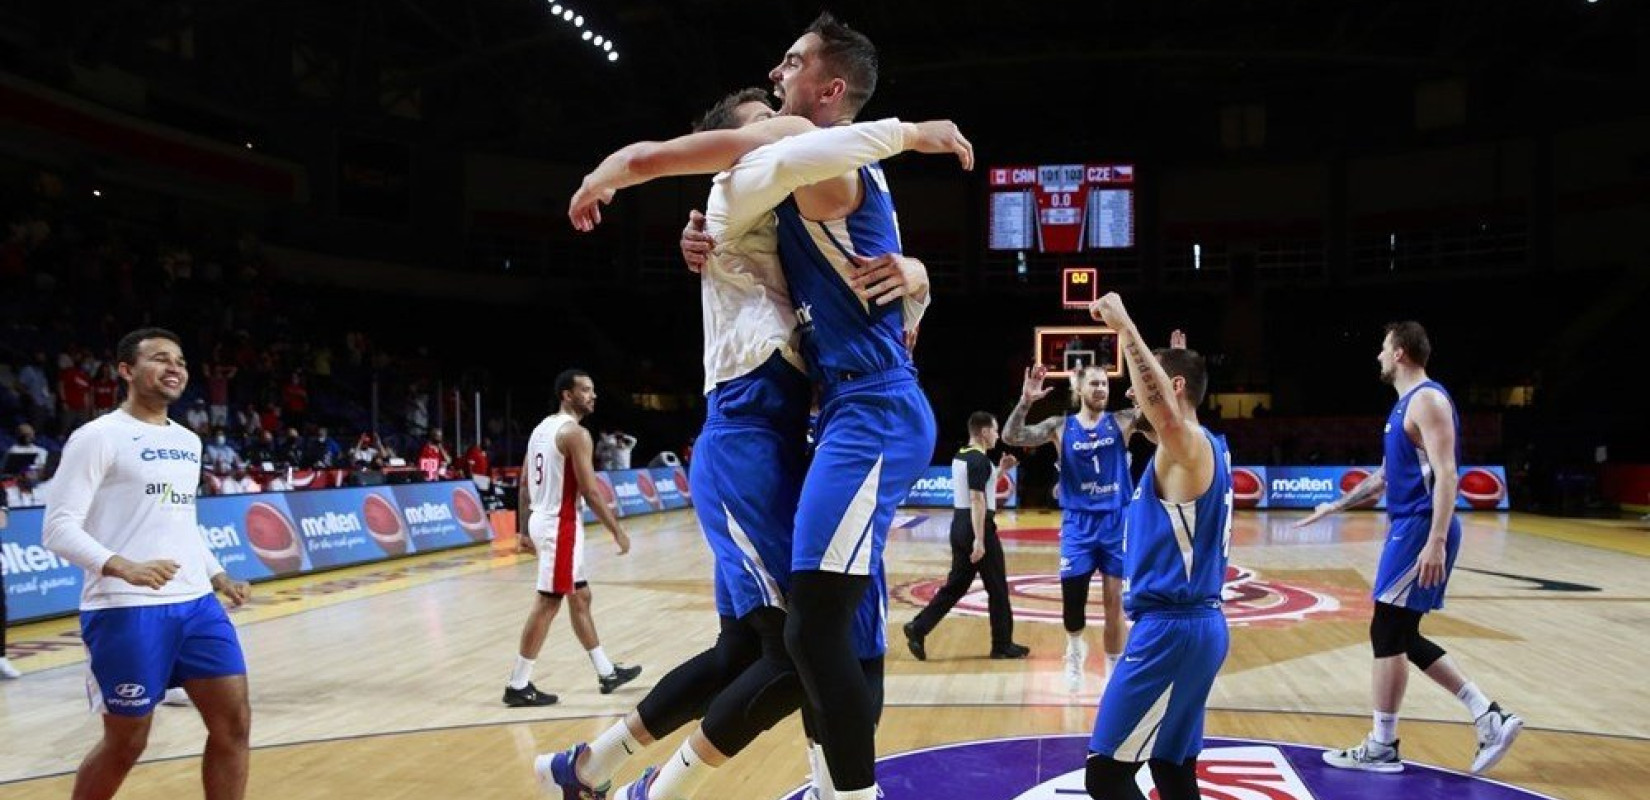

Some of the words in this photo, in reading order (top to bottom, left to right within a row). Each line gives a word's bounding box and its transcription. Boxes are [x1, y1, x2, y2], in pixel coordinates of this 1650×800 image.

[1012, 168, 1036, 183] CAN
[1087, 166, 1111, 181] CZE
[1051, 193, 1072, 207] 0.0
[794, 301, 813, 321] nk
[1091, 455, 1100, 474] 1
[911, 476, 955, 490] molte
[1272, 477, 1333, 491] molten
[404, 502, 452, 525] molten
[301, 511, 362, 538] molten
[199, 523, 241, 549] ten
